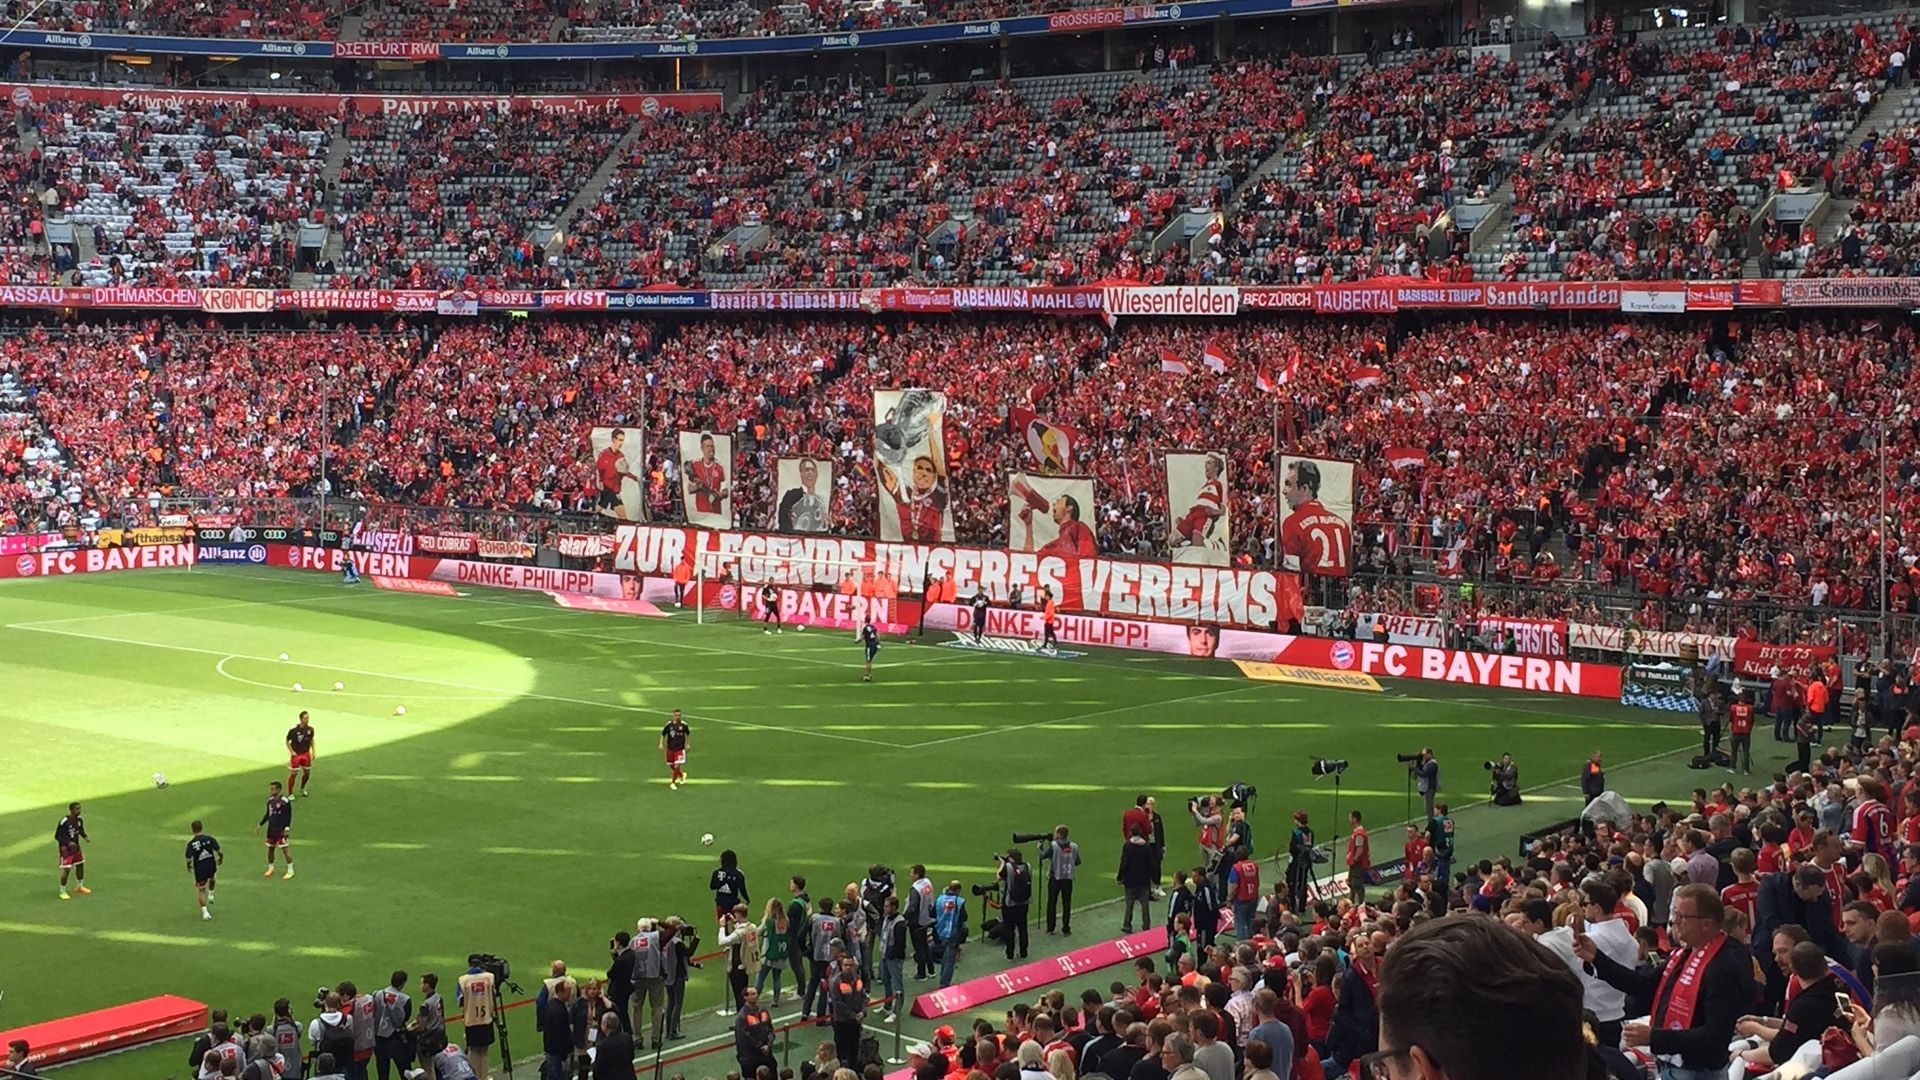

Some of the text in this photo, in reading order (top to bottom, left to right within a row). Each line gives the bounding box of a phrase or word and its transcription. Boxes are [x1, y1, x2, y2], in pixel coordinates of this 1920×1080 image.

[1050, 12, 1123, 27] GROSSHEIDE
[45, 35, 78, 45] Allianz
[261, 44, 293, 54] Allianz
[336, 43, 406, 56] DIETFURT
[466, 47, 495, 56] Allianz
[658, 45, 687, 54] Allianz
[95, 288, 197, 306] DITHMARSCHEN
[201, 289, 274, 310] KRONACH
[396, 296, 435, 307] SAW
[493, 292, 534, 305] SOFIA
[564, 290, 606, 307] KIST
[1107, 287, 1235, 313] Wiesenfelden
[1242, 292, 1267, 306] BFC
[1315, 289, 1397, 311] TAUBERTAL
[121, 530, 184, 545] Lfthansa
[198, 546, 246, 560] Allianz
[1310, 527, 1346, 568] 21
[41, 542, 194, 575] FC BAYERN
[302, 547, 325, 569] FC
[457, 561, 518, 589] DANKE,
[523, 566, 594, 593] PHILIPP!
[614, 526, 686, 574] ZUR
[694, 531, 867, 586] LEGENDE
[875, 543, 1066, 607] UNSERES
[1079, 558, 1278, 627] VEREINS
[780, 589, 889, 624] BAYERN
[956, 607, 1040, 639] DNKE,
[1361, 642, 1581, 695] FC BAYERN
[475, 1005, 486, 1018] 15
